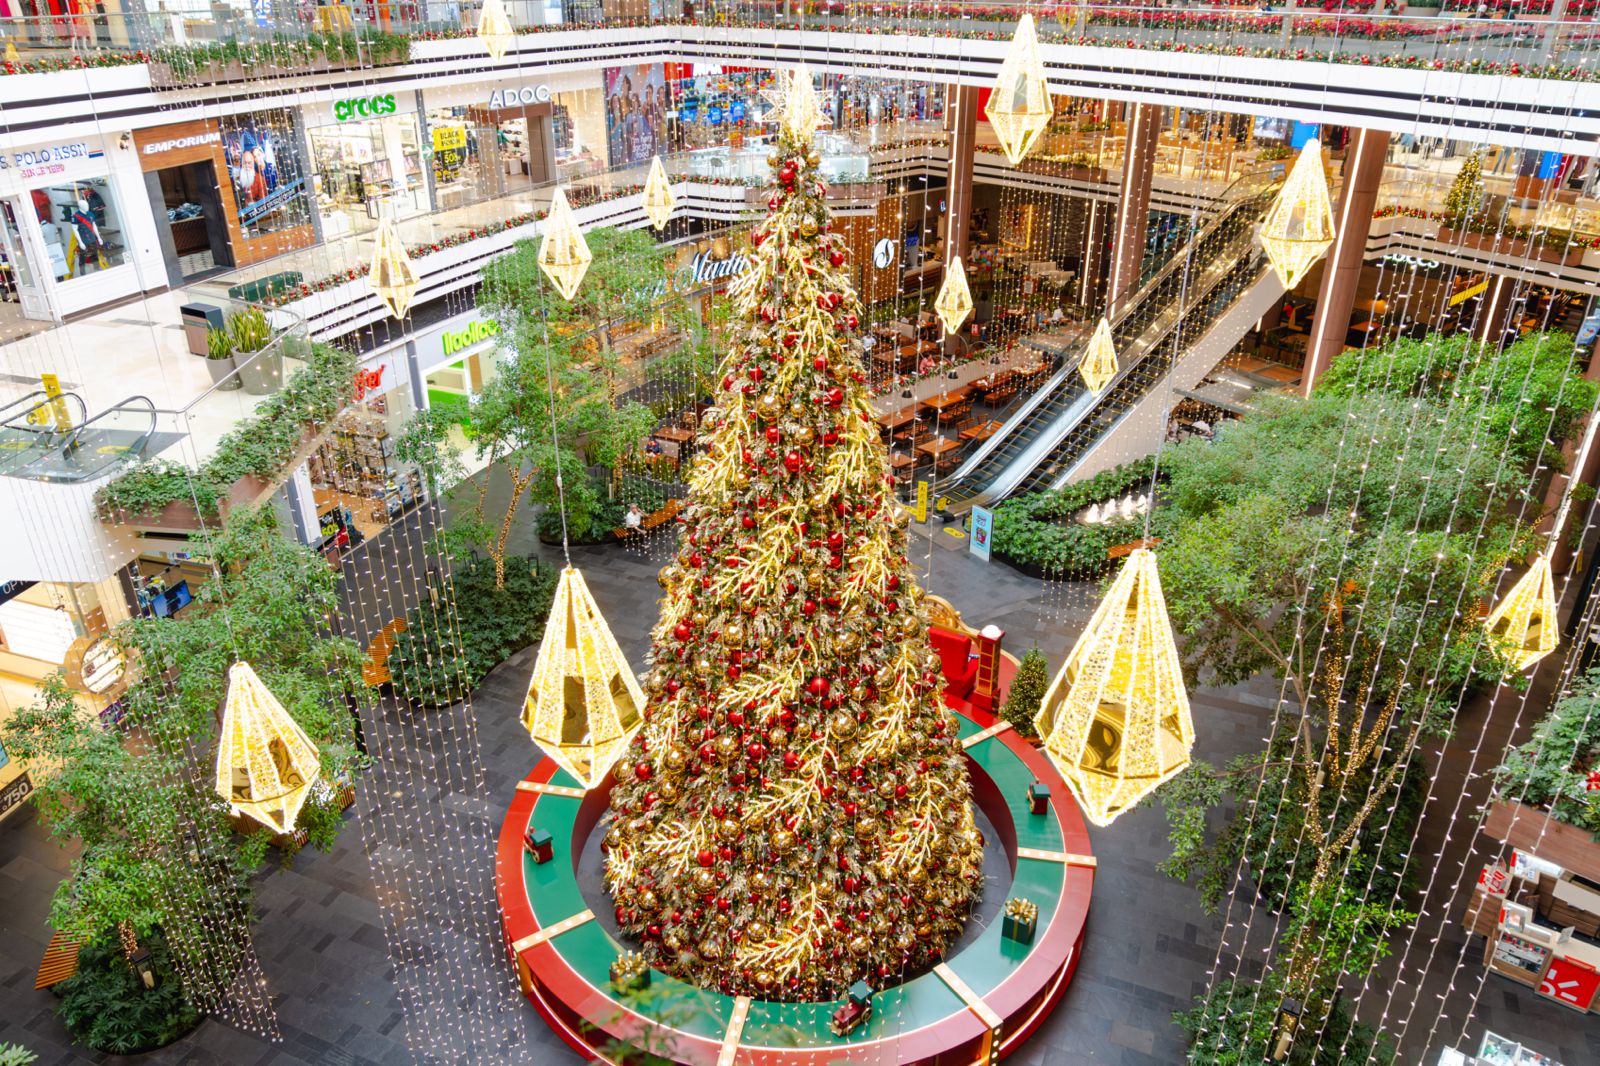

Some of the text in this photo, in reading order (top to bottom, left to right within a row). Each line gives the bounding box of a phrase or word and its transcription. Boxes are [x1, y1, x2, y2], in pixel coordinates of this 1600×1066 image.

[335, 94, 397, 121] crocs
[489, 85, 552, 110] ADOC
[14, 148, 51, 167] POLO
[53, 143, 88, 161] ASSN
[143, 132, 221, 155] EMPORIUM
